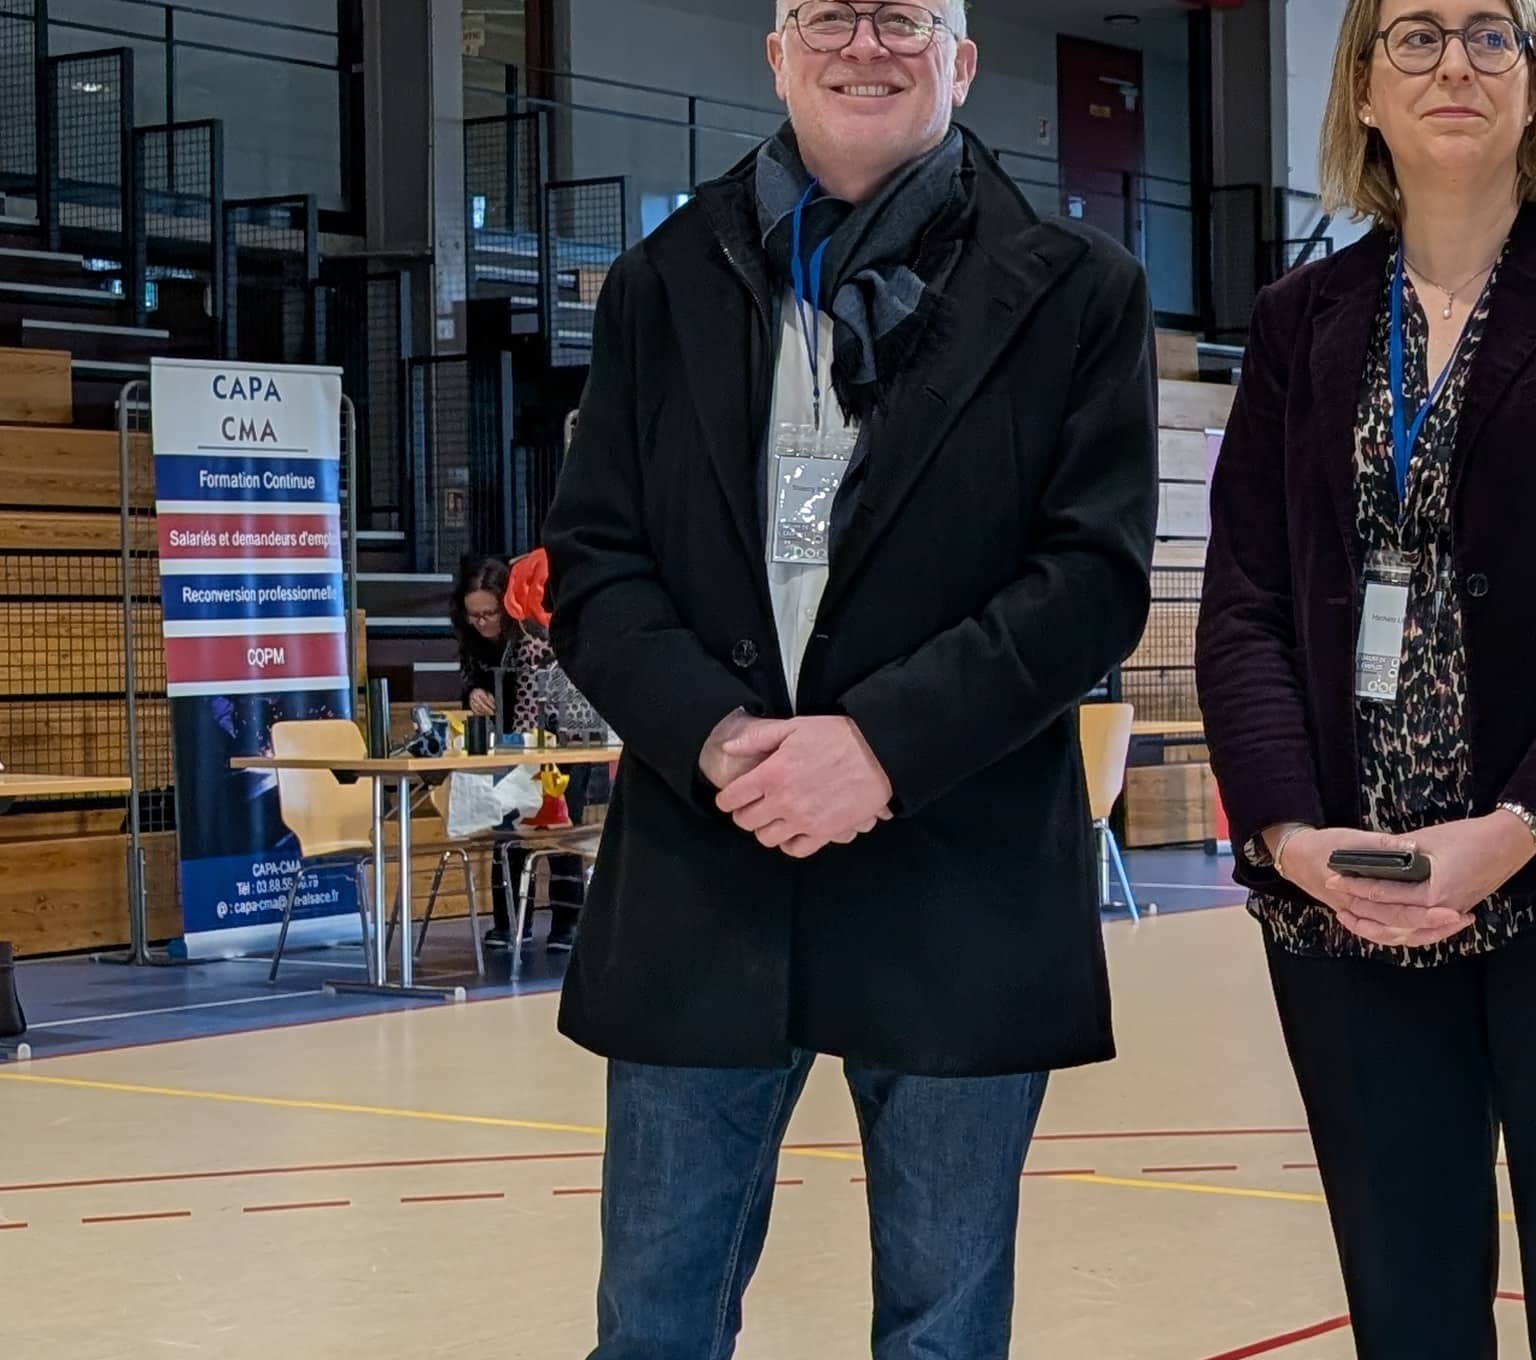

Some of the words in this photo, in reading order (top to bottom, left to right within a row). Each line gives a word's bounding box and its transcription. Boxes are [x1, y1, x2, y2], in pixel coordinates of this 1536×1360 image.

[212, 374, 282, 402] CAPA
[221, 416, 278, 443] CMA
[199, 469, 260, 489] Formation
[263, 471, 316, 490] Continue
[169, 529, 217, 547] Salariés
[218, 532, 231, 547] et
[232, 530, 298, 547] demandeurs
[298, 530, 337, 550] d'emp
[181, 586, 257, 603] Reconversion
[247, 647, 285, 668] CQPM
